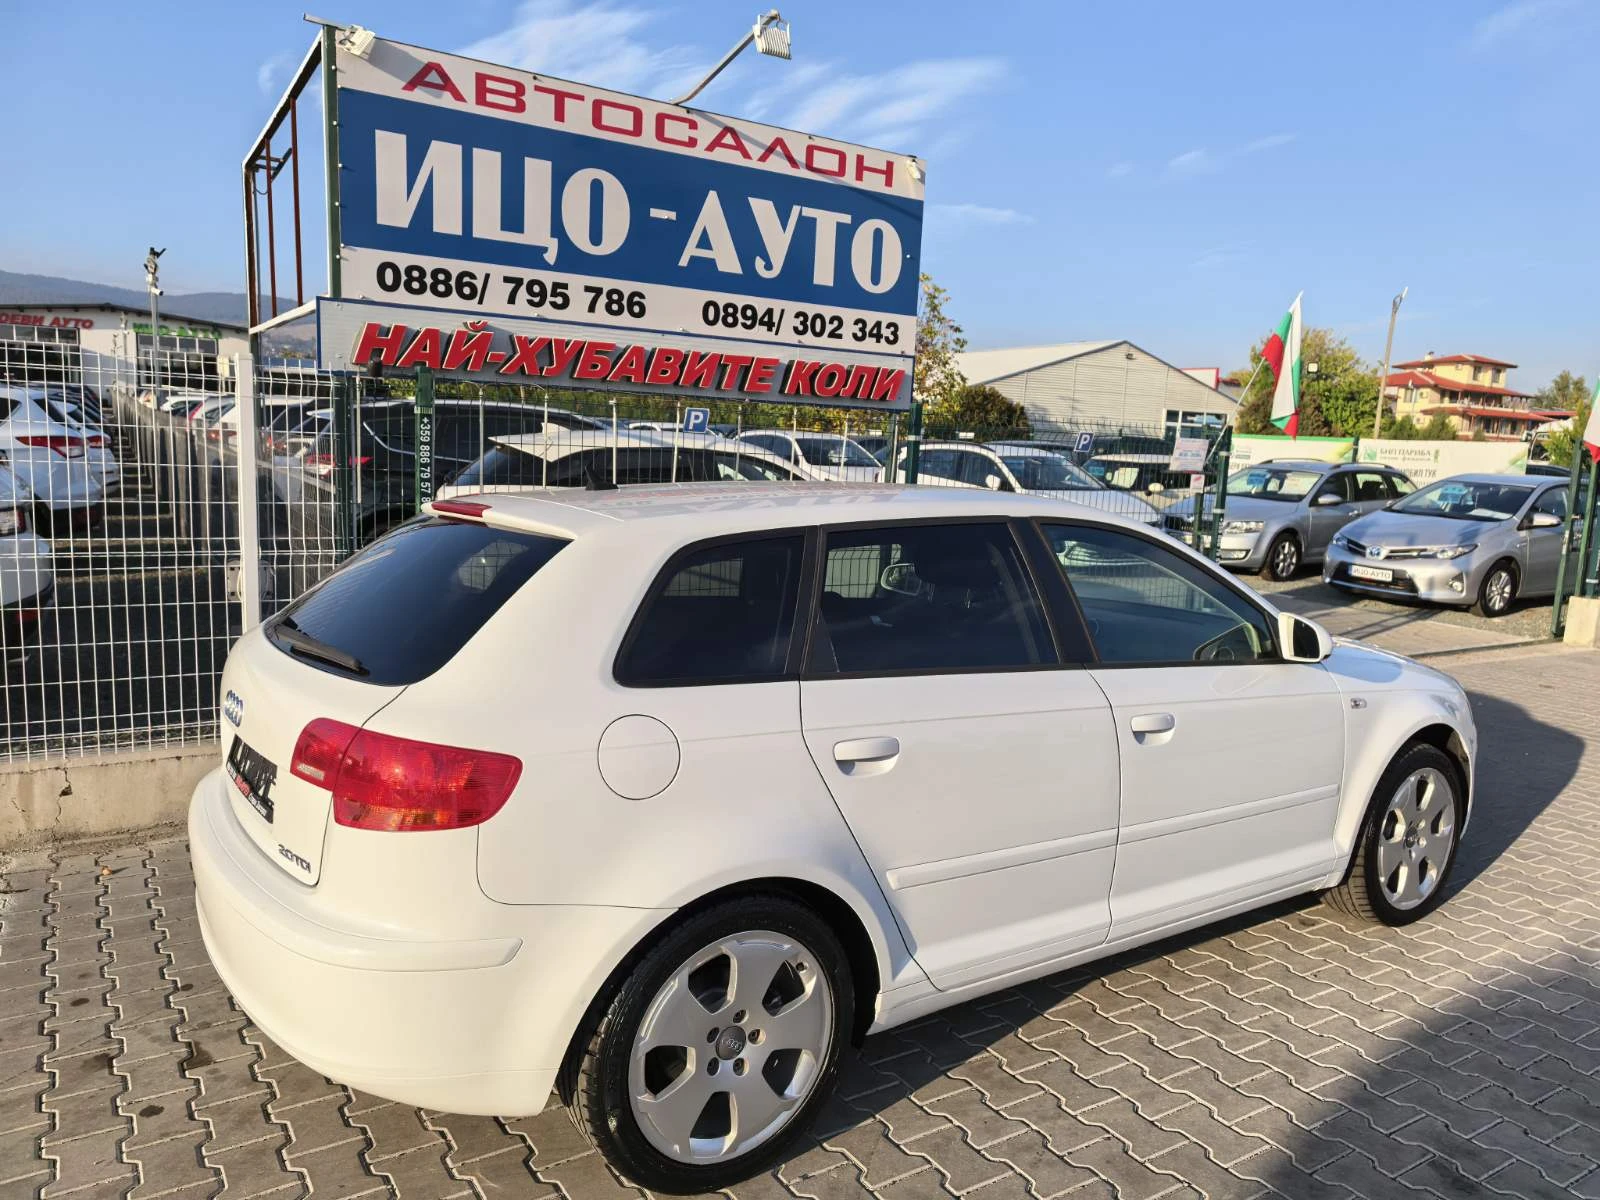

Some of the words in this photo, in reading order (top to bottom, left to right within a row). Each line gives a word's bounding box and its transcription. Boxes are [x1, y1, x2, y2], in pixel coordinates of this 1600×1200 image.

[402, 61, 895, 188] АВТОСАЛОН
[374, 129, 631, 266] ИЦО
[376, 261, 490, 305] 0886/
[502, 275, 570, 310] 795
[583, 285, 647, 319] 786
[702, 300, 785, 336] 0894/
[792, 311, 844, 339] 302
[851, 318, 900, 346] 343
[351, 319, 780, 393] НАЙ-ХУБАВИТЕ
[783, 358, 907, 401] КОЛИ
[420, 416, 431, 442] +359
[688, 411, 704, 430] P
[420, 445, 431, 464] 886
[1079, 433, 1091, 450] P
[420, 466, 431, 479] 79
[420, 481, 432, 494] 57
